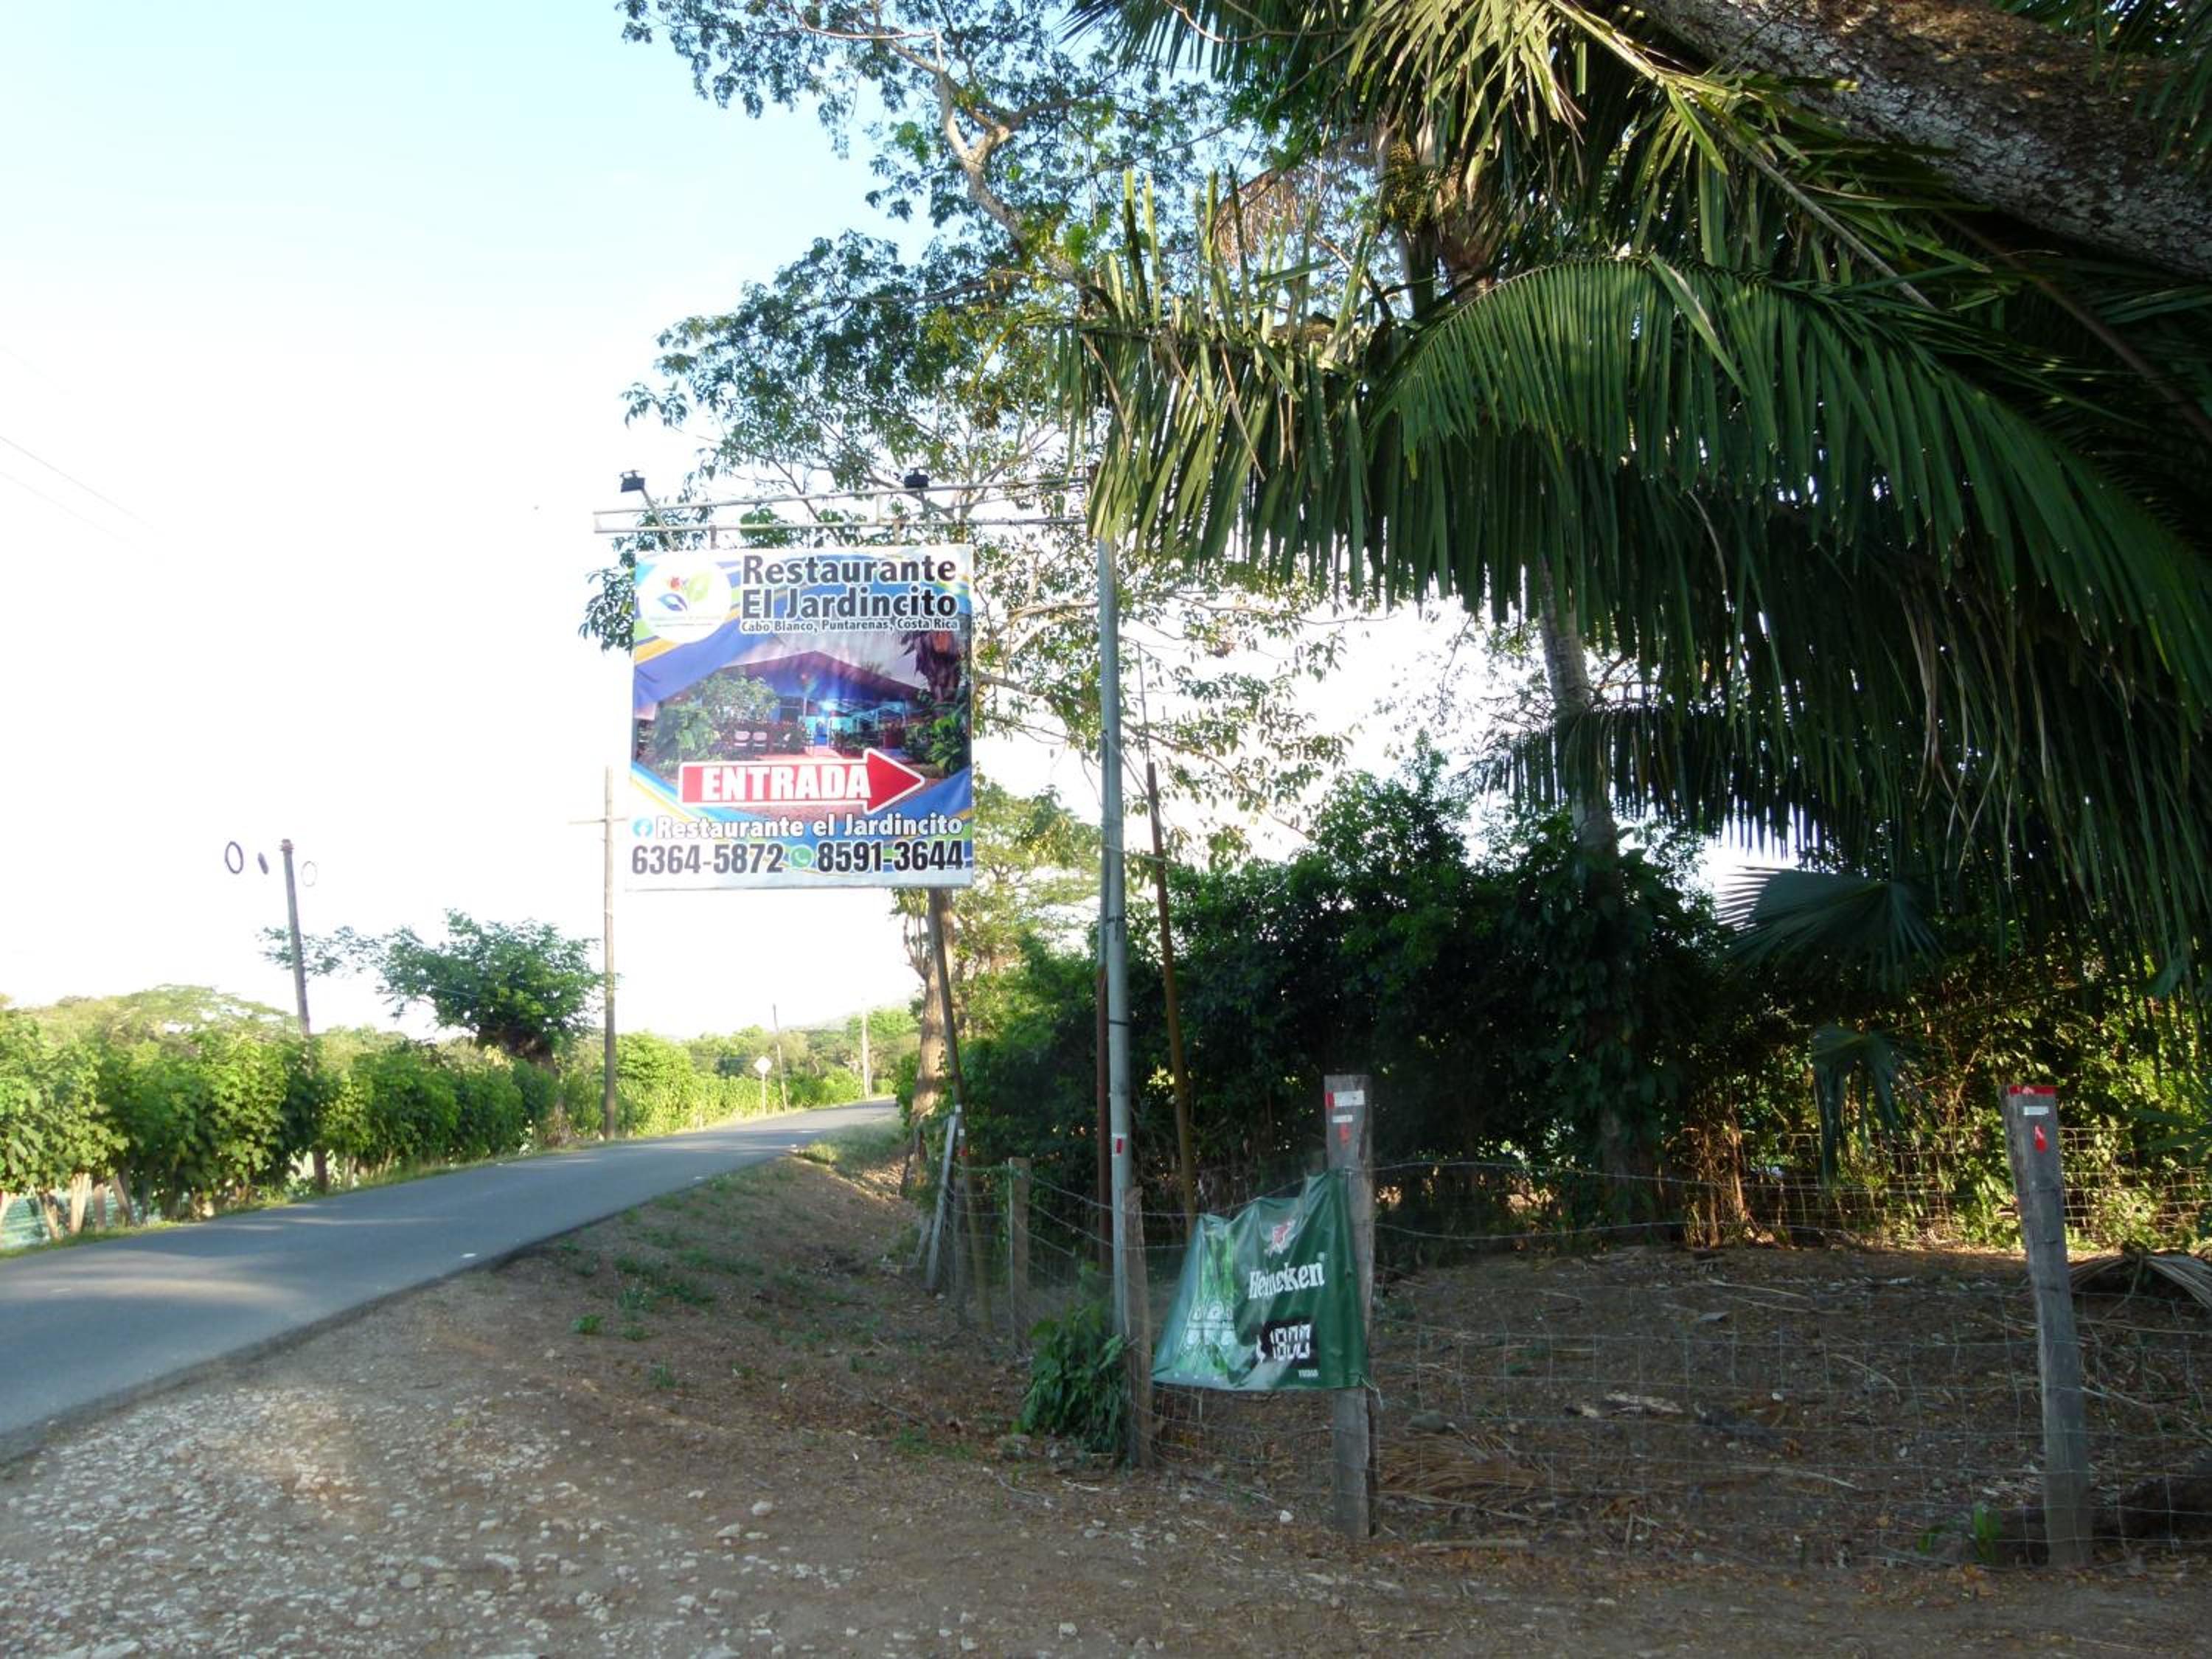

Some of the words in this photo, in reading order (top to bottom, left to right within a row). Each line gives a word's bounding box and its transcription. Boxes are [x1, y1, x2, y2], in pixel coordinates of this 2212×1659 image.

[742, 554, 957, 585] Restaurante
[742, 590, 772, 619] El
[787, 587, 958, 619] Jardincito
[742, 621, 771, 632] Cabo
[774, 620, 818, 633] Blanco,
[822, 619, 894, 631] Puntarenas,
[897, 618, 931, 629] Costa
[933, 618, 958, 628] Rica
[702, 765, 872, 802] ENTRADA
[655, 816, 804, 839] Restaurante
[813, 815, 835, 836] el
[844, 813, 964, 836] Jardincito
[631, 843, 785, 875] 6364-5872
[817, 840, 964, 873] 8591-3644
[1248, 1262, 1325, 1300] Heineken
